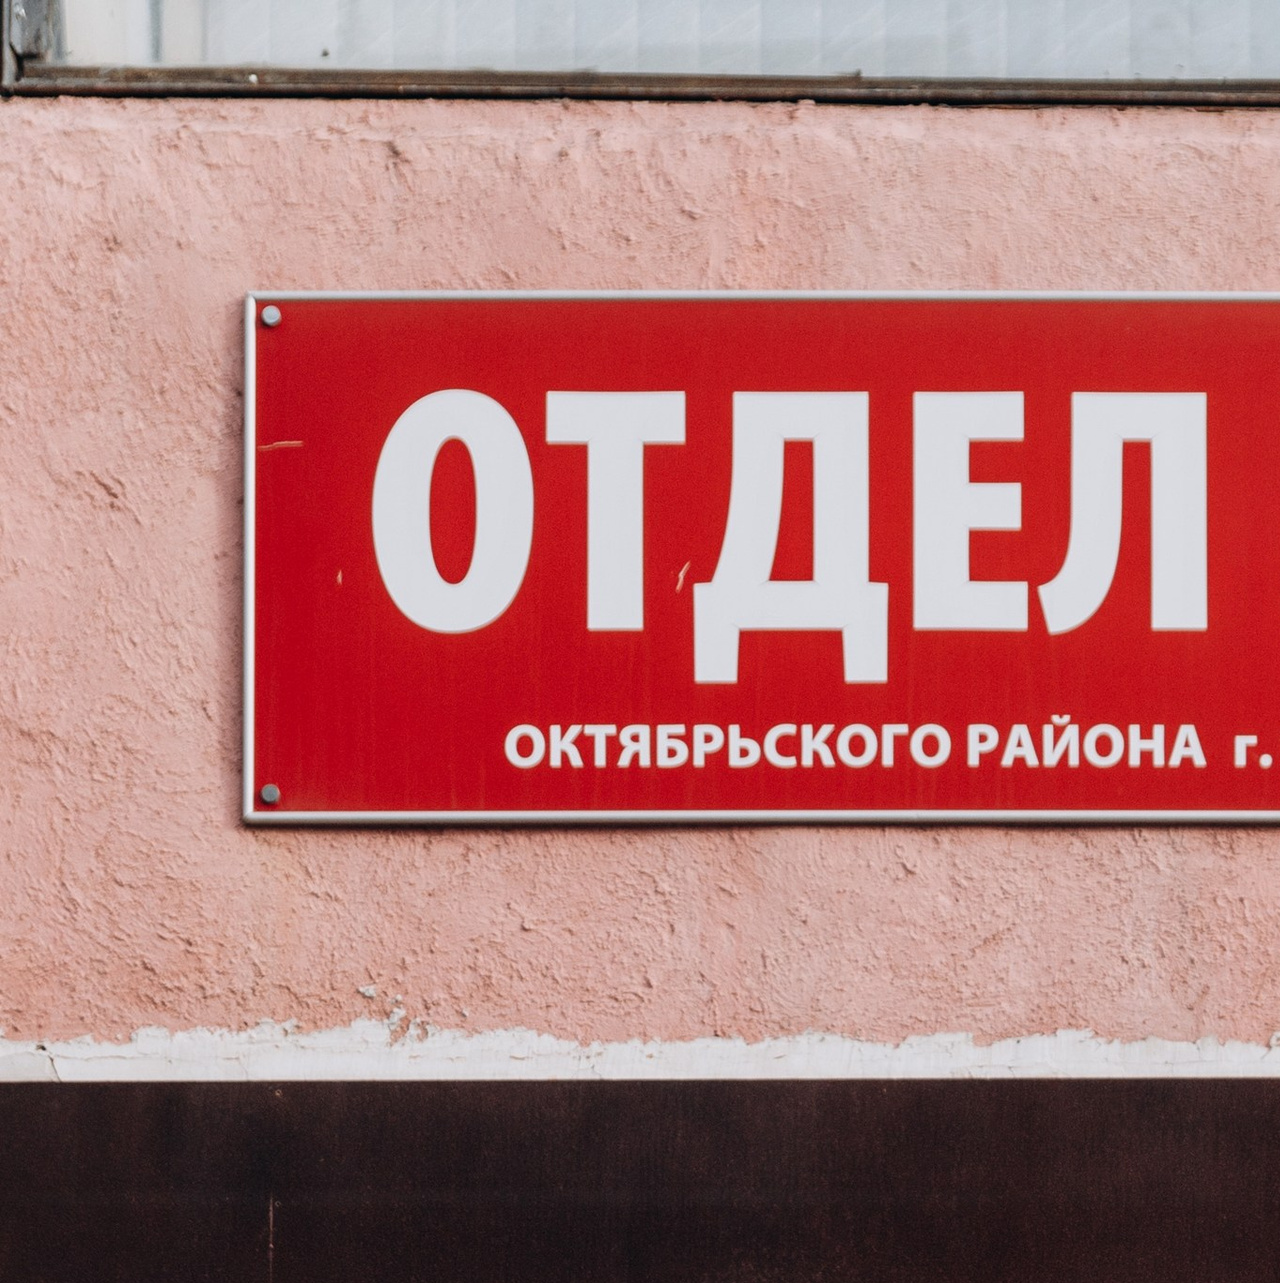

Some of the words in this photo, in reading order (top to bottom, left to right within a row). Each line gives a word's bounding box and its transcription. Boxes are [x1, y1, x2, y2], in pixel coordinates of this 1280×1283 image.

[372, 389, 1208, 687] ОТДЕЛ
[505, 724, 951, 769] ОКТЯБРЬСКОГО
[968, 714, 1207, 769] РАЙОНА
[1234, 735, 1274, 769] г.
